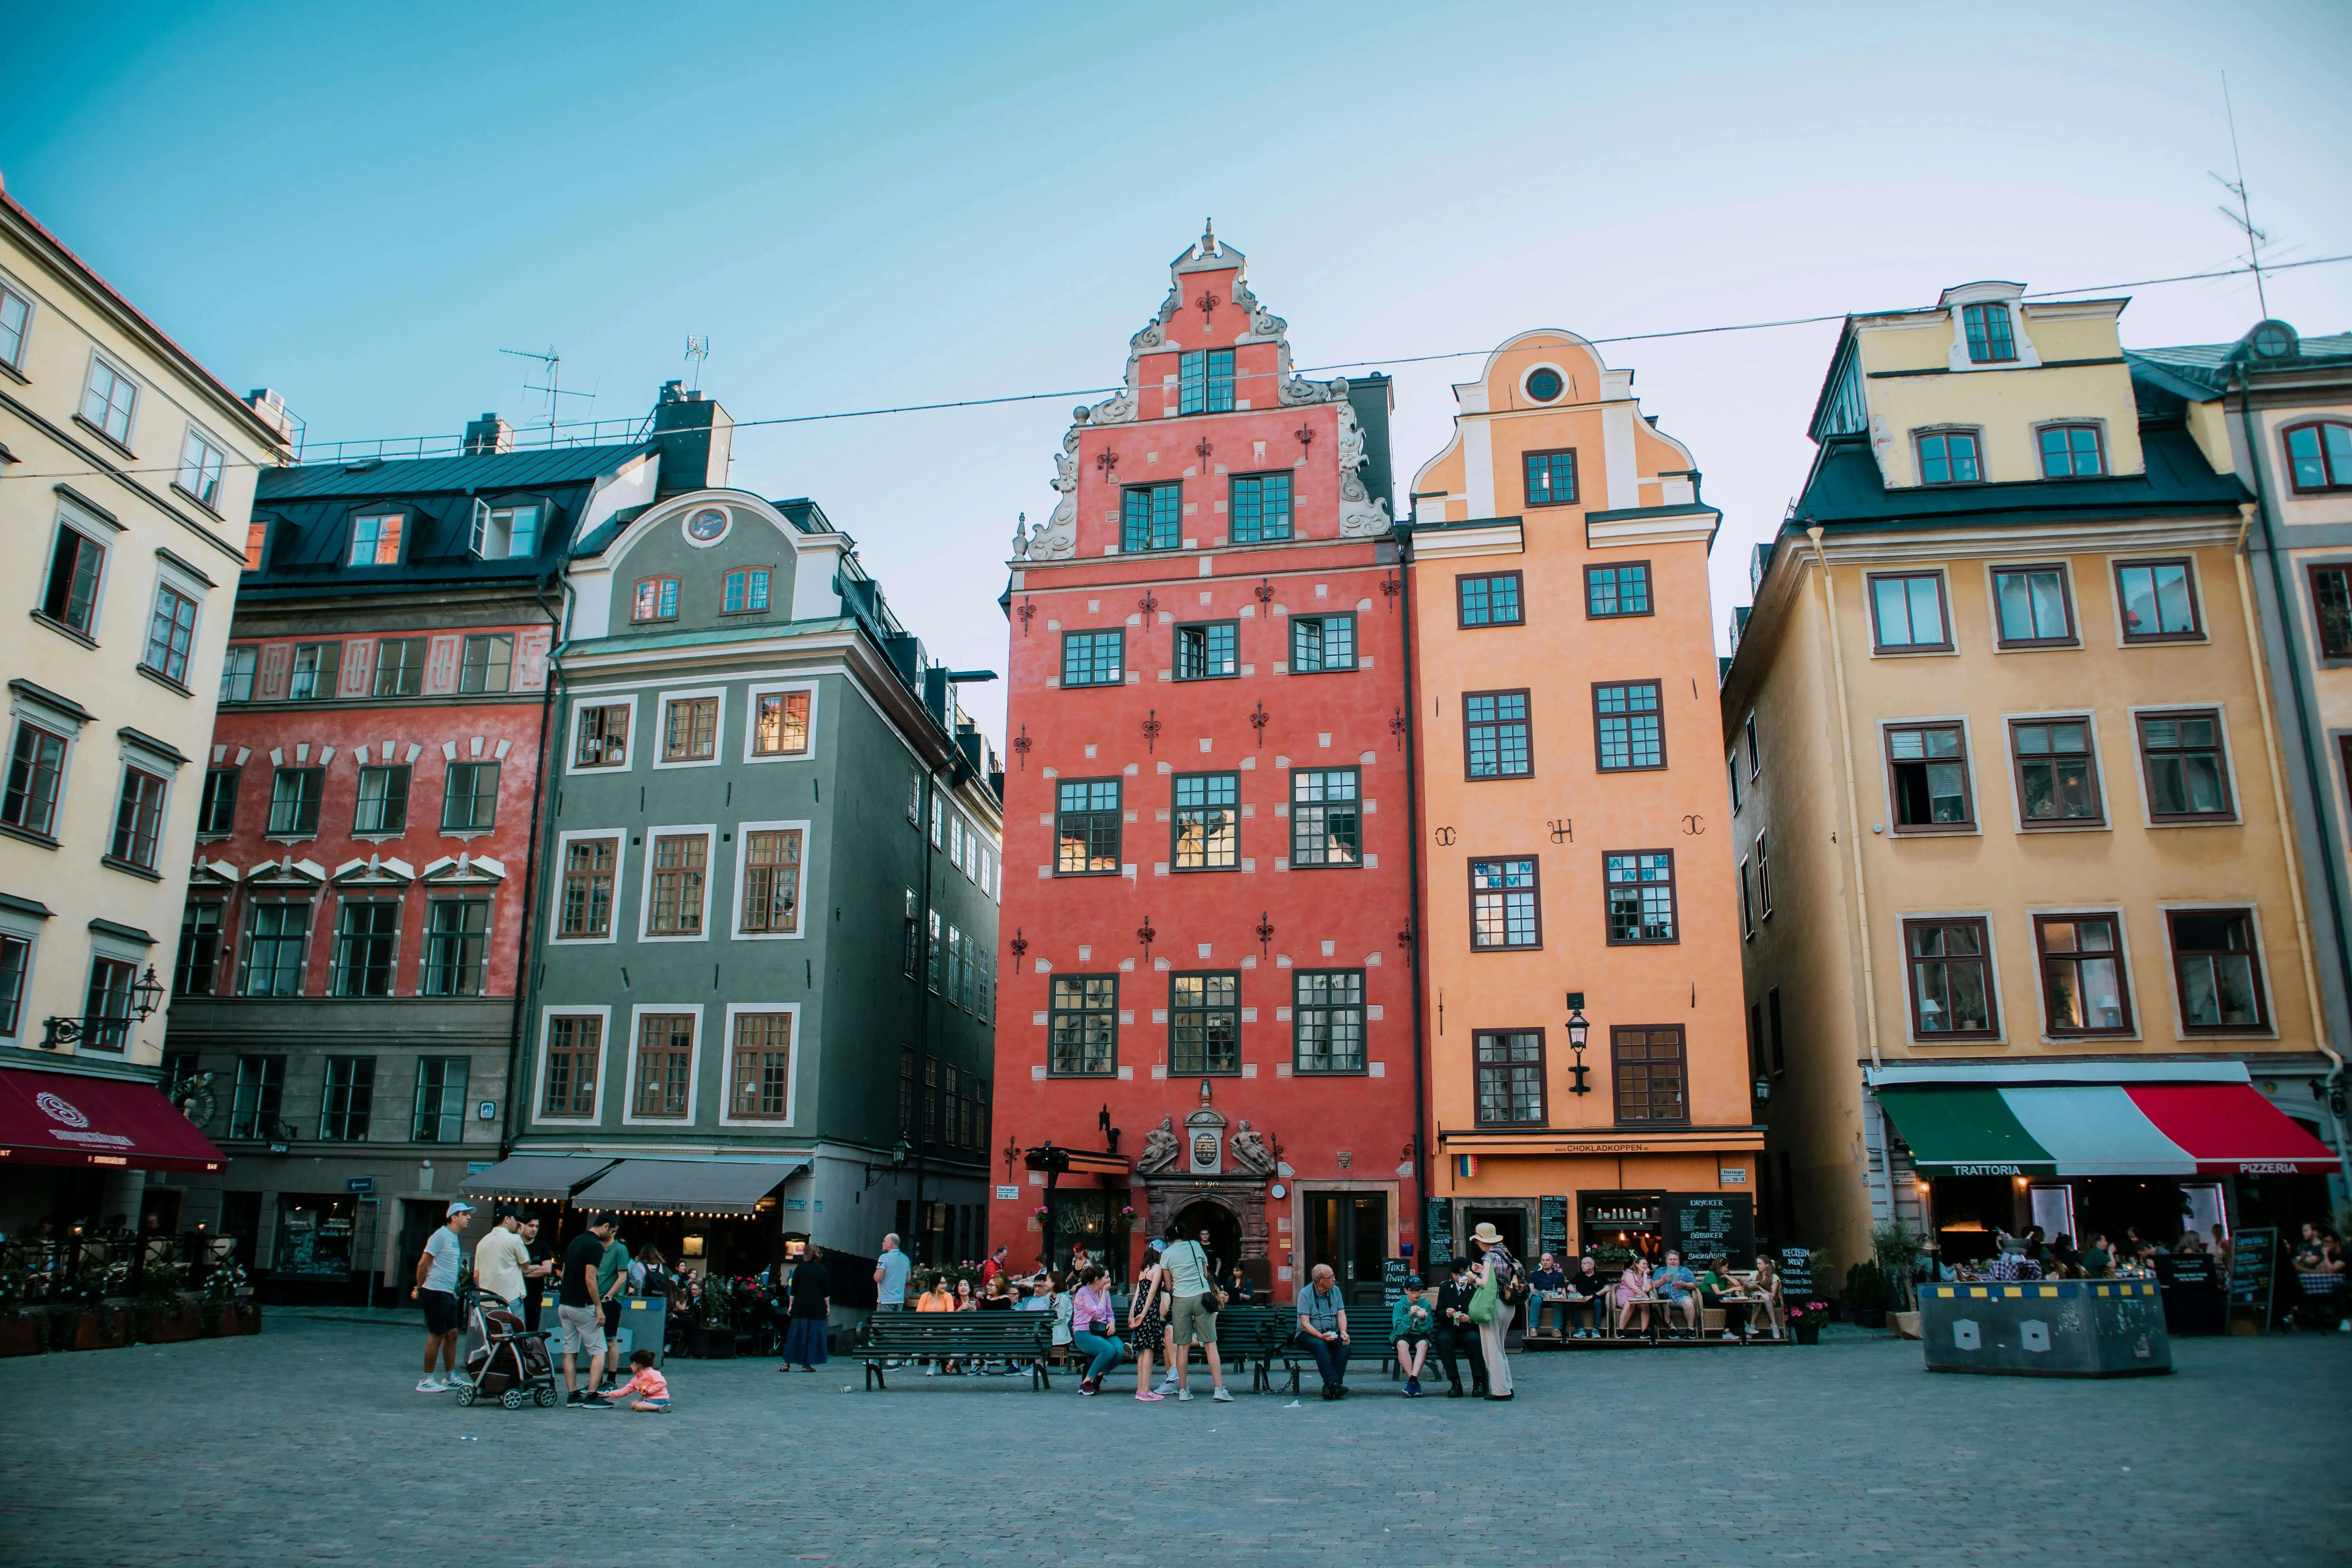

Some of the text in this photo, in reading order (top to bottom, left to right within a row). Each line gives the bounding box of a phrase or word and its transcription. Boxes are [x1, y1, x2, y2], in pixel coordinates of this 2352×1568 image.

[1952, 1165, 2021, 1175] TRATTORIA
[2239, 1163, 2298, 1173] PIZZERIA
[632, 1202, 669, 1210] Restaurang
[1688, 1251, 1728, 1260] SMÖRGÅSAR
[1385, 1261, 1406, 1271] TAKE
[1386, 1274, 1408, 1286] AWAY
